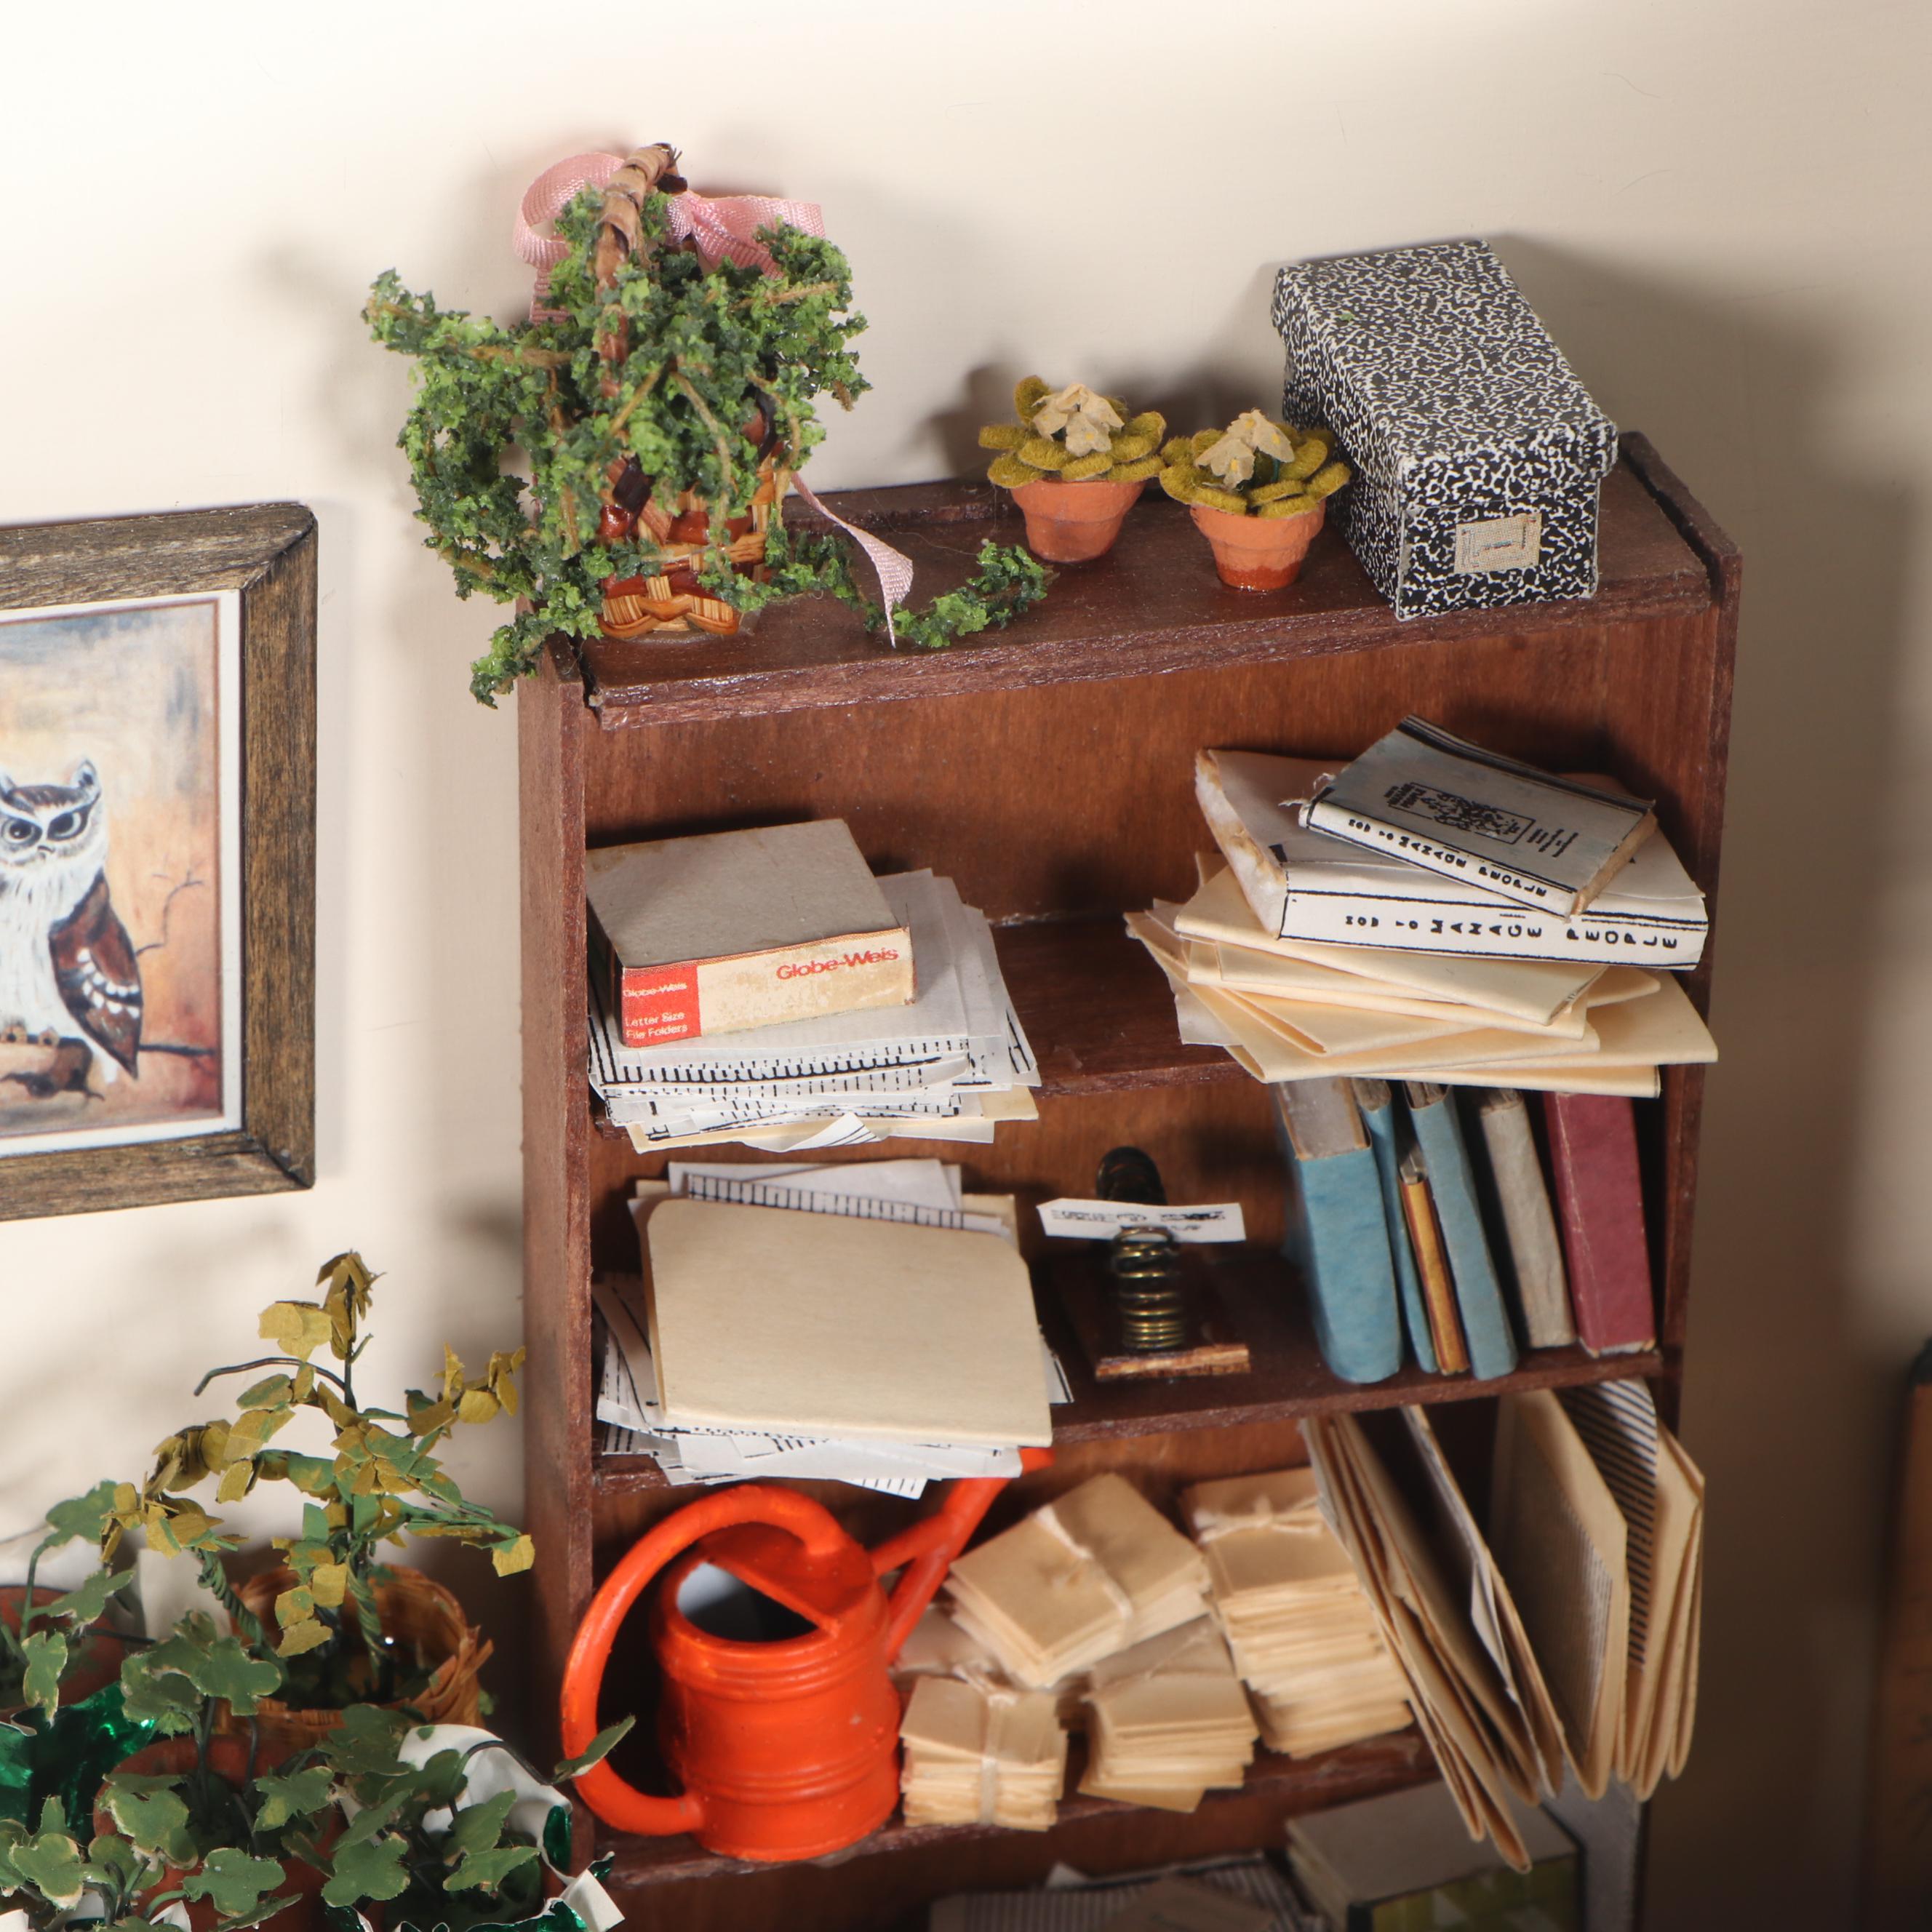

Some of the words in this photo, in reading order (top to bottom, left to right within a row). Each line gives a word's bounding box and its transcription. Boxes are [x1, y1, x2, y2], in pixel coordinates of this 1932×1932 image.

[1398, 836, 1467, 869] MANAGE
[1478, 866, 1547, 898] PEOPLE
[1345, 915, 1379, 927] HOW
[1430, 919, 1542, 938] MANAGE
[1566, 927, 1678, 949] PEOPLE
[775, 947, 900, 981] Globe-Weis
[626, 1017, 659, 1027] Letter
[662, 1012, 686, 1023] Size
[626, 1029, 646, 1039] File
[648, 1024, 688, 1037] Folders
